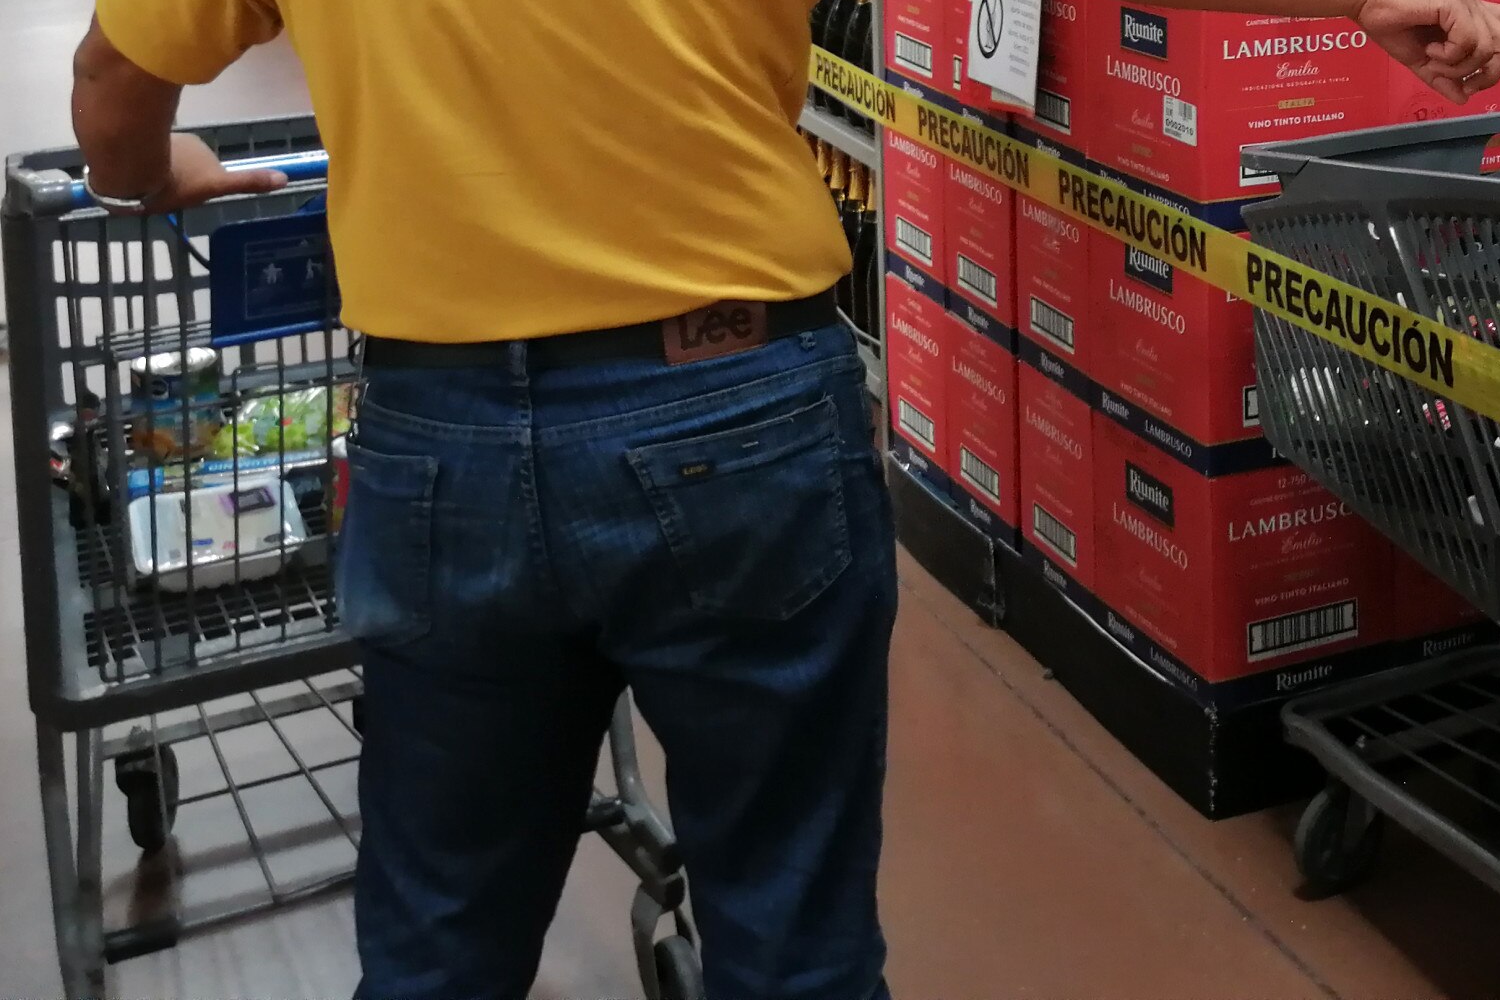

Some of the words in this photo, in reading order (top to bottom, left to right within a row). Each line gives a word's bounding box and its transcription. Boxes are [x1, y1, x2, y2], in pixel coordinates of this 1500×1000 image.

[1124, 15, 1164, 44] Riunite
[1223, 30, 1367, 60] LAMBRUSCO
[816, 53, 896, 123] PRECAUCIÓN
[1106, 55, 1181, 97] LAMBRUSCO
[1275, 60, 1320, 79] Emilia
[1248, 117, 1272, 128] VINO
[1273, 115, 1301, 126] TINTO
[1303, 112, 1345, 123] ITALIANO
[889, 131, 938, 169] LAMBRUSCO
[918, 105, 1030, 189] PRECAUCIÓN
[950, 162, 1002, 205] LAMBRUSCO
[1022, 199, 1080, 244] LAMBRUSCO
[1058, 168, 1207, 272] PRECAUCIÓN
[679, 307, 752, 350] Lee
[1109, 278, 1186, 335] LAMBRUSCO
[1247, 251, 1454, 388] PRECAUCIÓN
[892, 312, 939, 357] LAMBRUSCO
[952, 356, 1006, 404] LAMBRUSCO
[1026, 406, 1082, 461] LAMBRUSCO
[1102, 391, 1130, 419] Riunite
[1145, 419, 1192, 458] LAMBRUSCO
[1130, 470, 1170, 508] Riunite
[1112, 502, 1188, 571] LAMBRUSCO
[1276, 663, 1333, 690] Riunite
